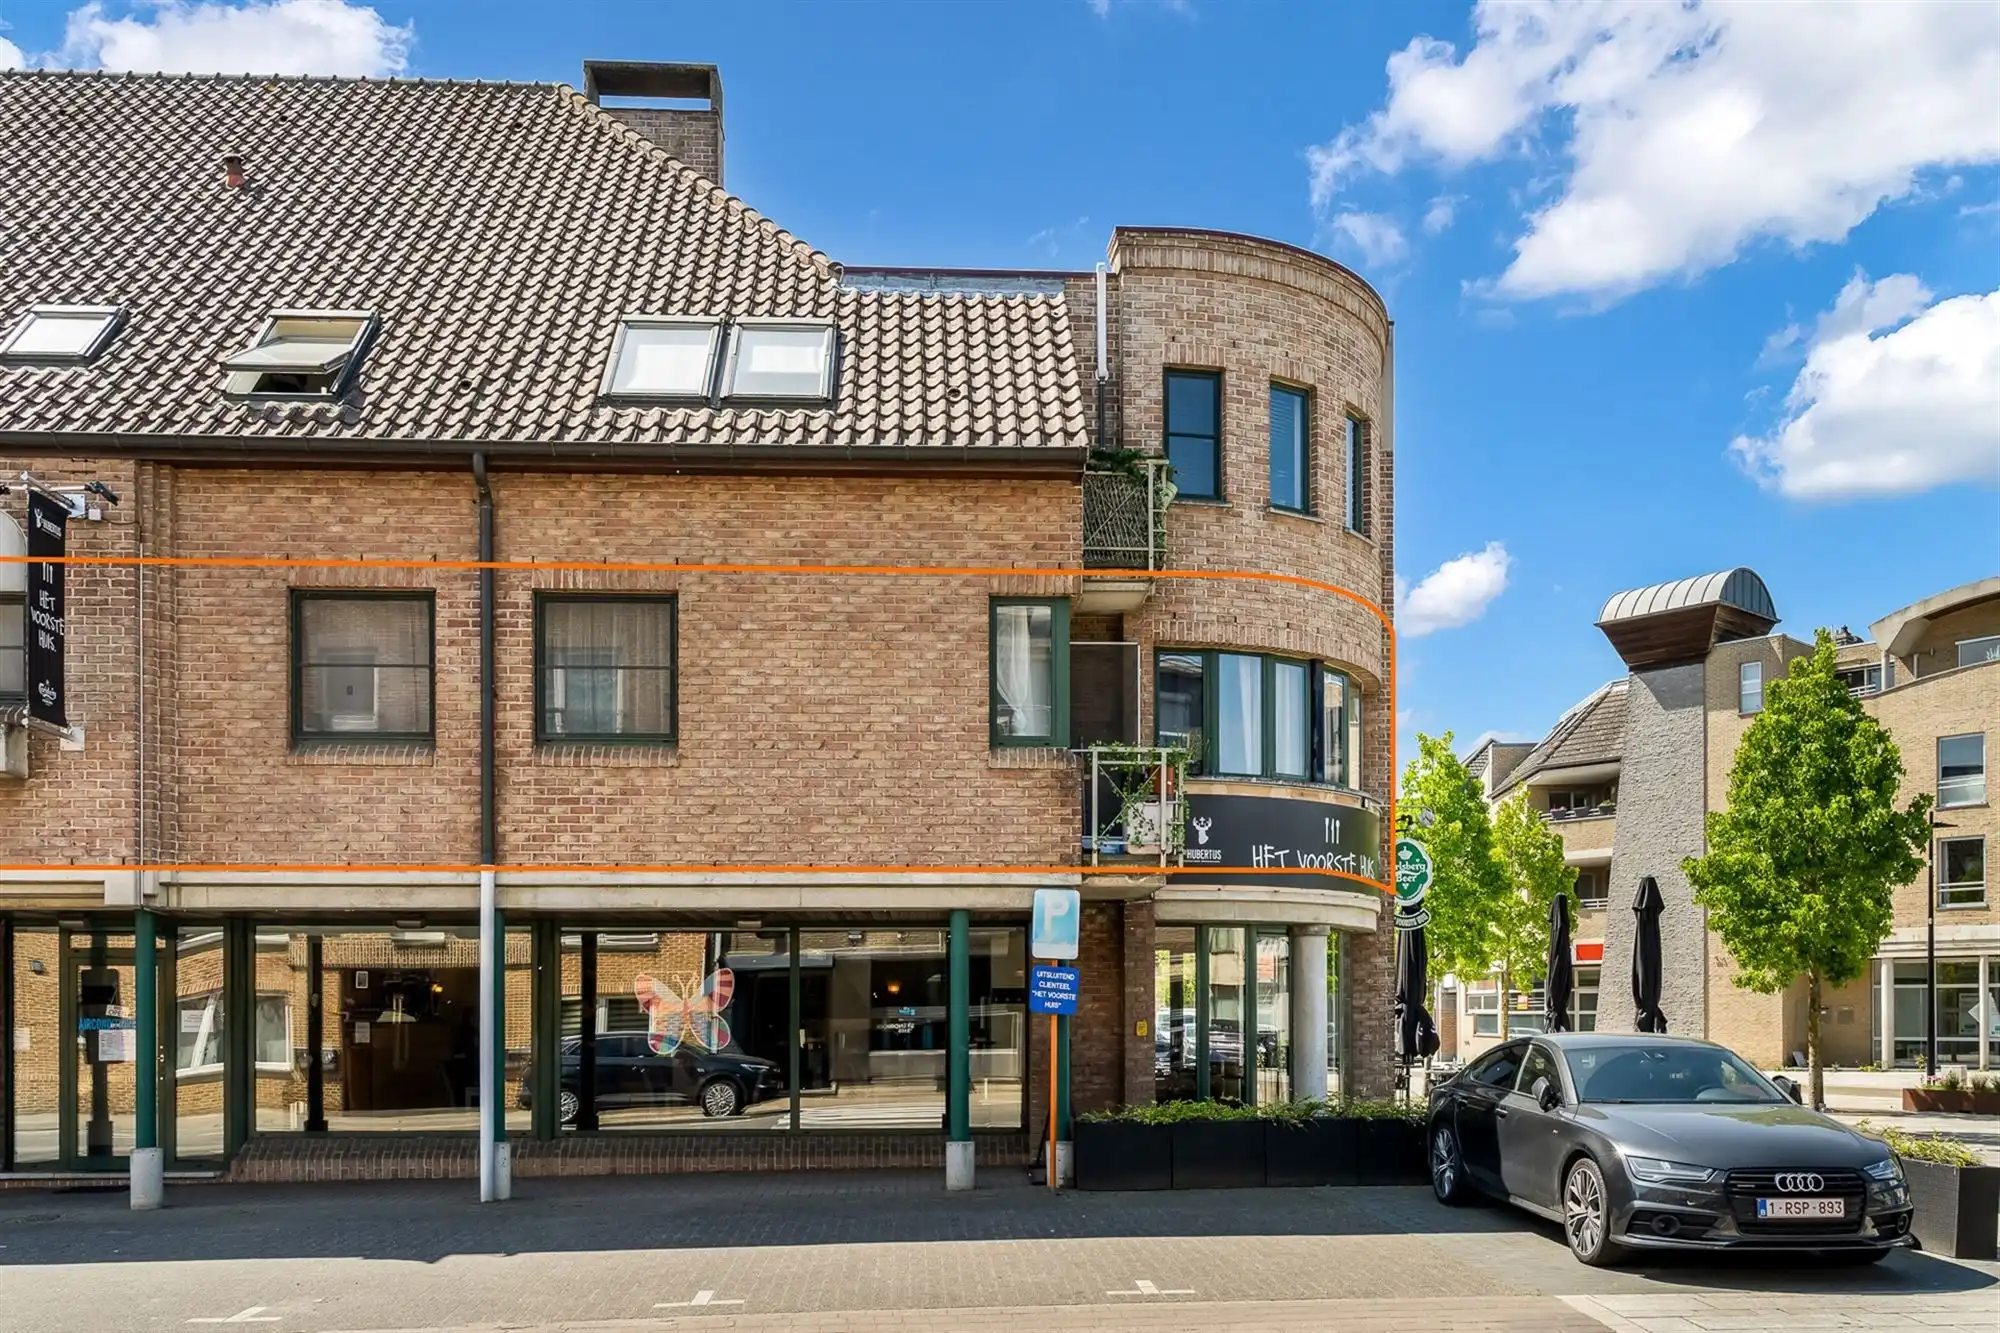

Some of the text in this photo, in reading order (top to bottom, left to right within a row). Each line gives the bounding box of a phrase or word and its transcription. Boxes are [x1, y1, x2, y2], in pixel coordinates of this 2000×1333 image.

[39, 589, 56, 611] HET
[30, 605, 65, 636] VOORSTE
[1186, 849, 1222, 860] HUBERTUS
[1252, 844, 1290, 869] HET
[1396, 873, 1417, 883] Beer
[1044, 893, 1070, 936] P
[1036, 970, 1076, 981] UITSLUITEND
[1038, 981, 1071, 990] CLIENTEEL
[1047, 991, 1077, 1001] VOORSTE
